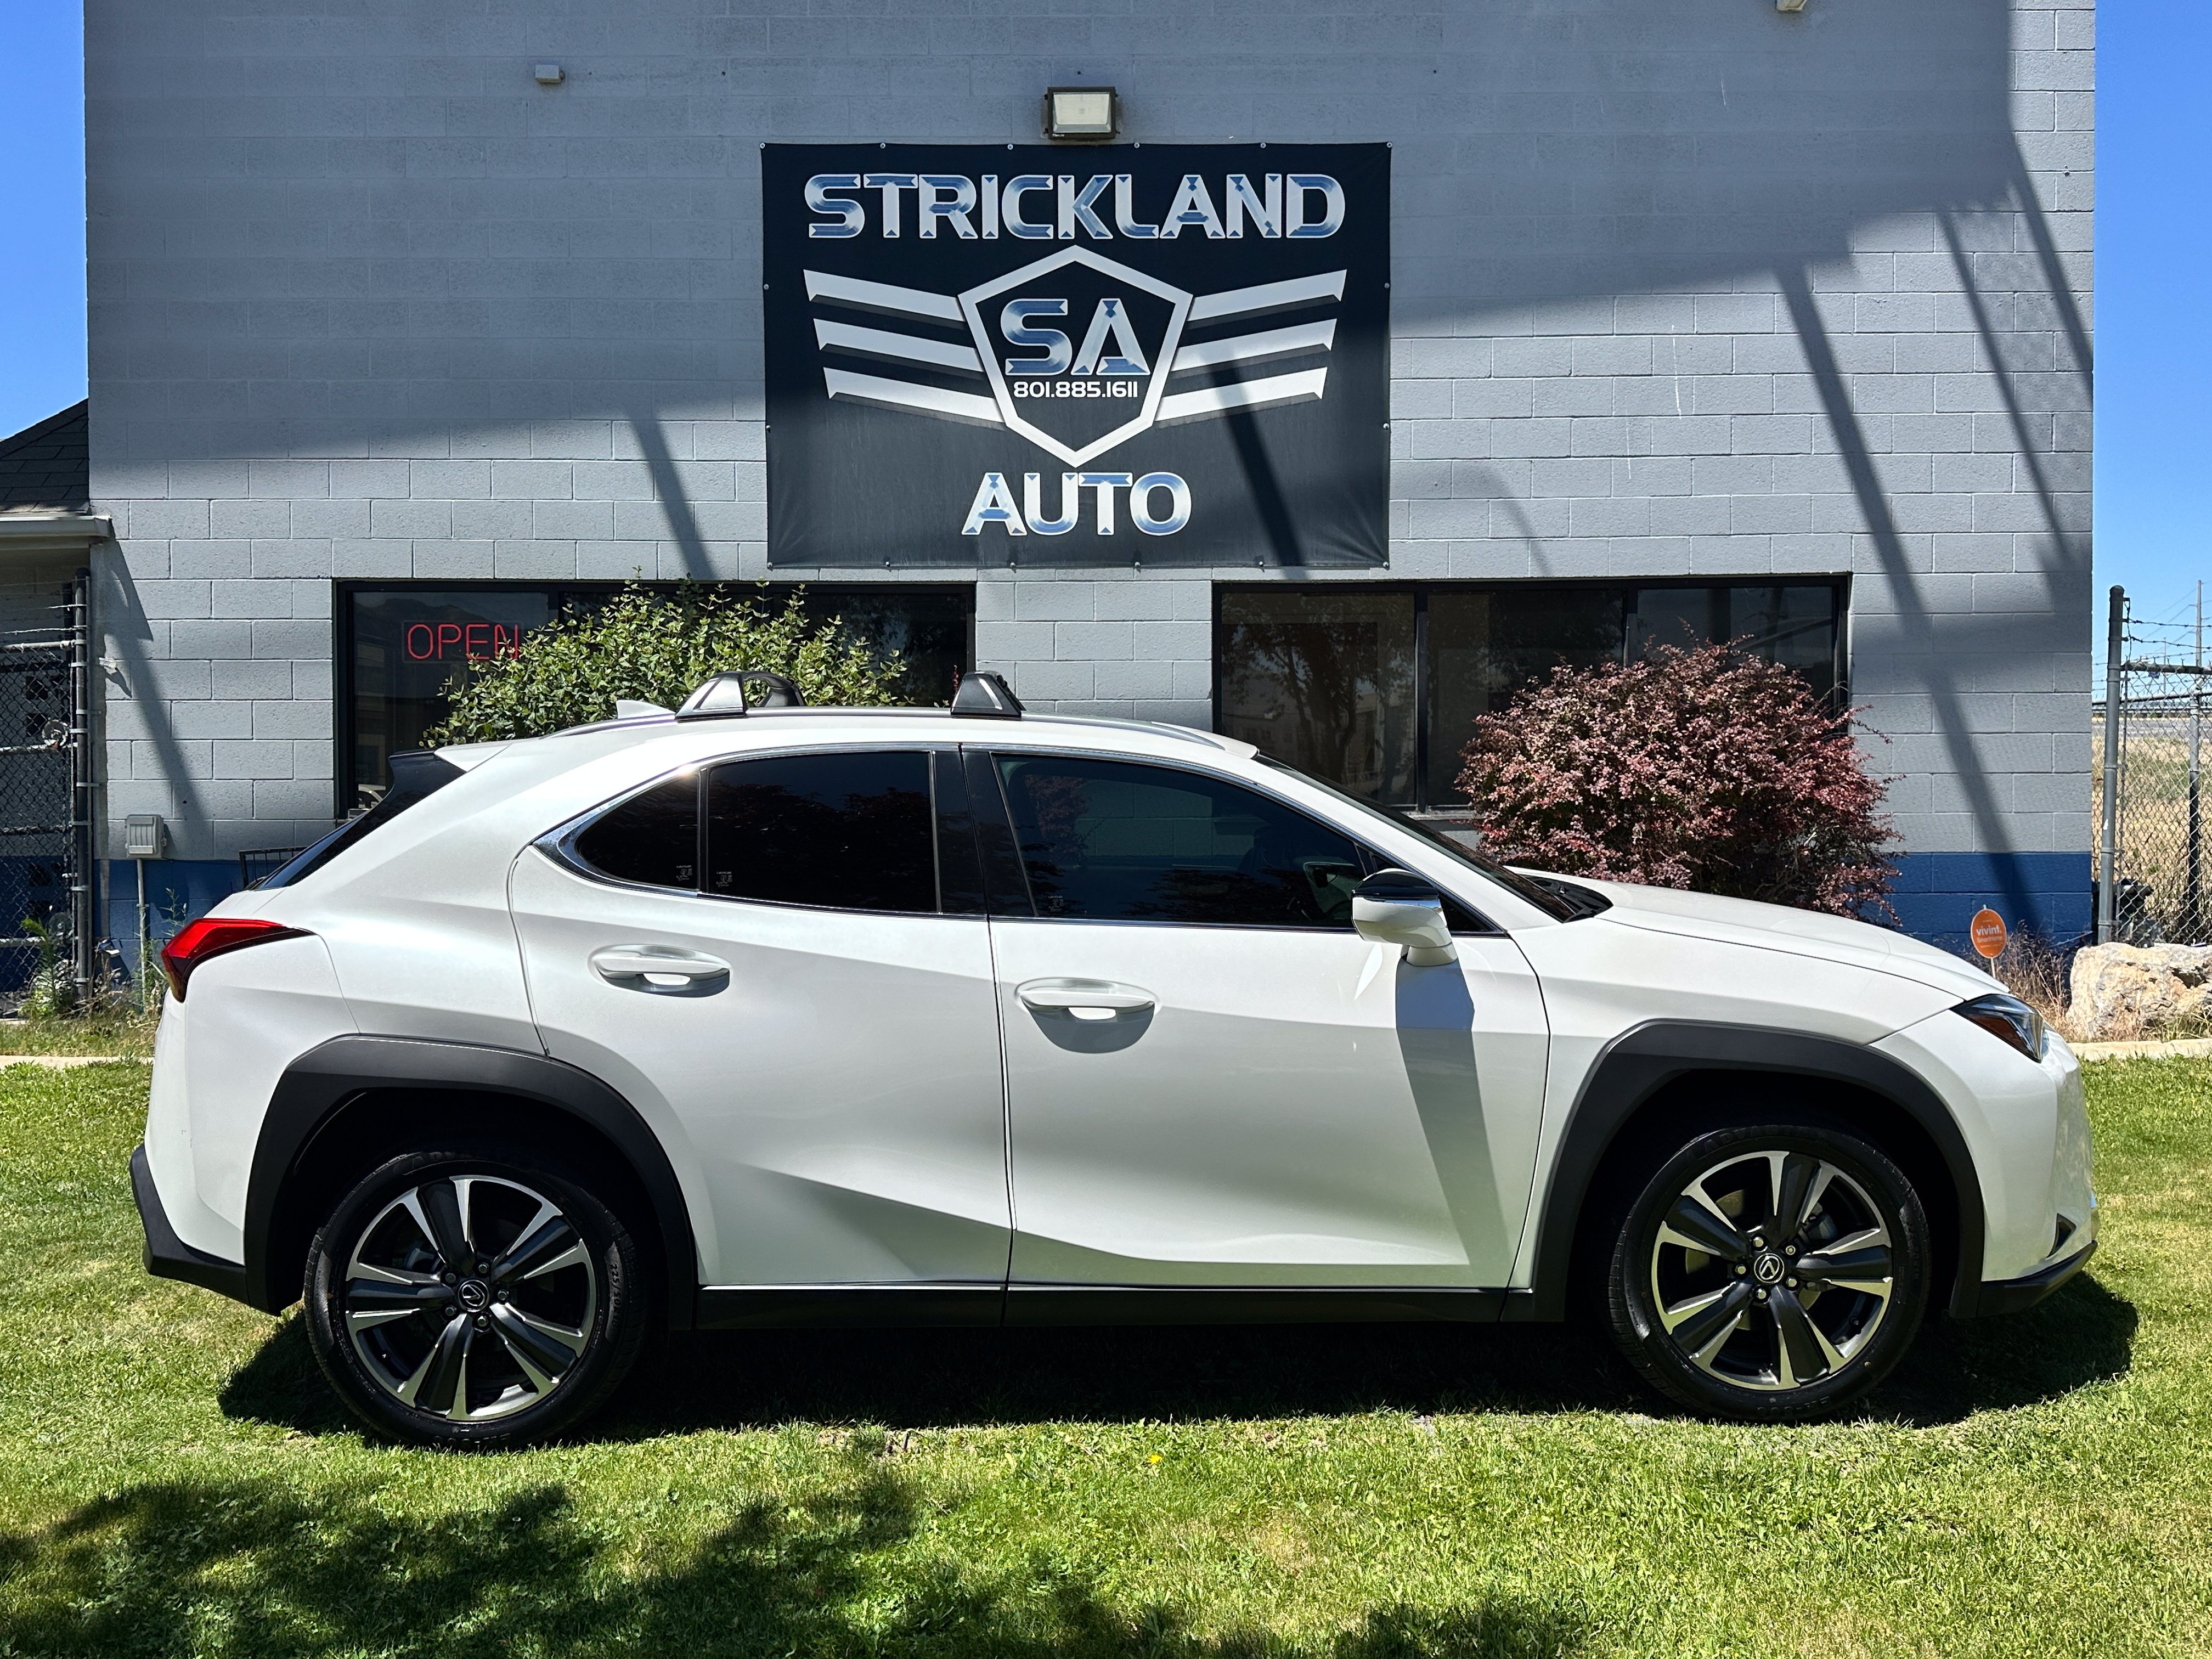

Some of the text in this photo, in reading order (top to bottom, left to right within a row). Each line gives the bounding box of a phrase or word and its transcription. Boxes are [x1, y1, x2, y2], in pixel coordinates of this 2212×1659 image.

[804, 173, 1346, 239] STRICKLAND
[1000, 298, 1151, 376] SA
[1013, 381, 1138, 398] 801.885.1611
[961, 472, 1192, 537] AUTO
[407, 623, 519, 660] OPEN
